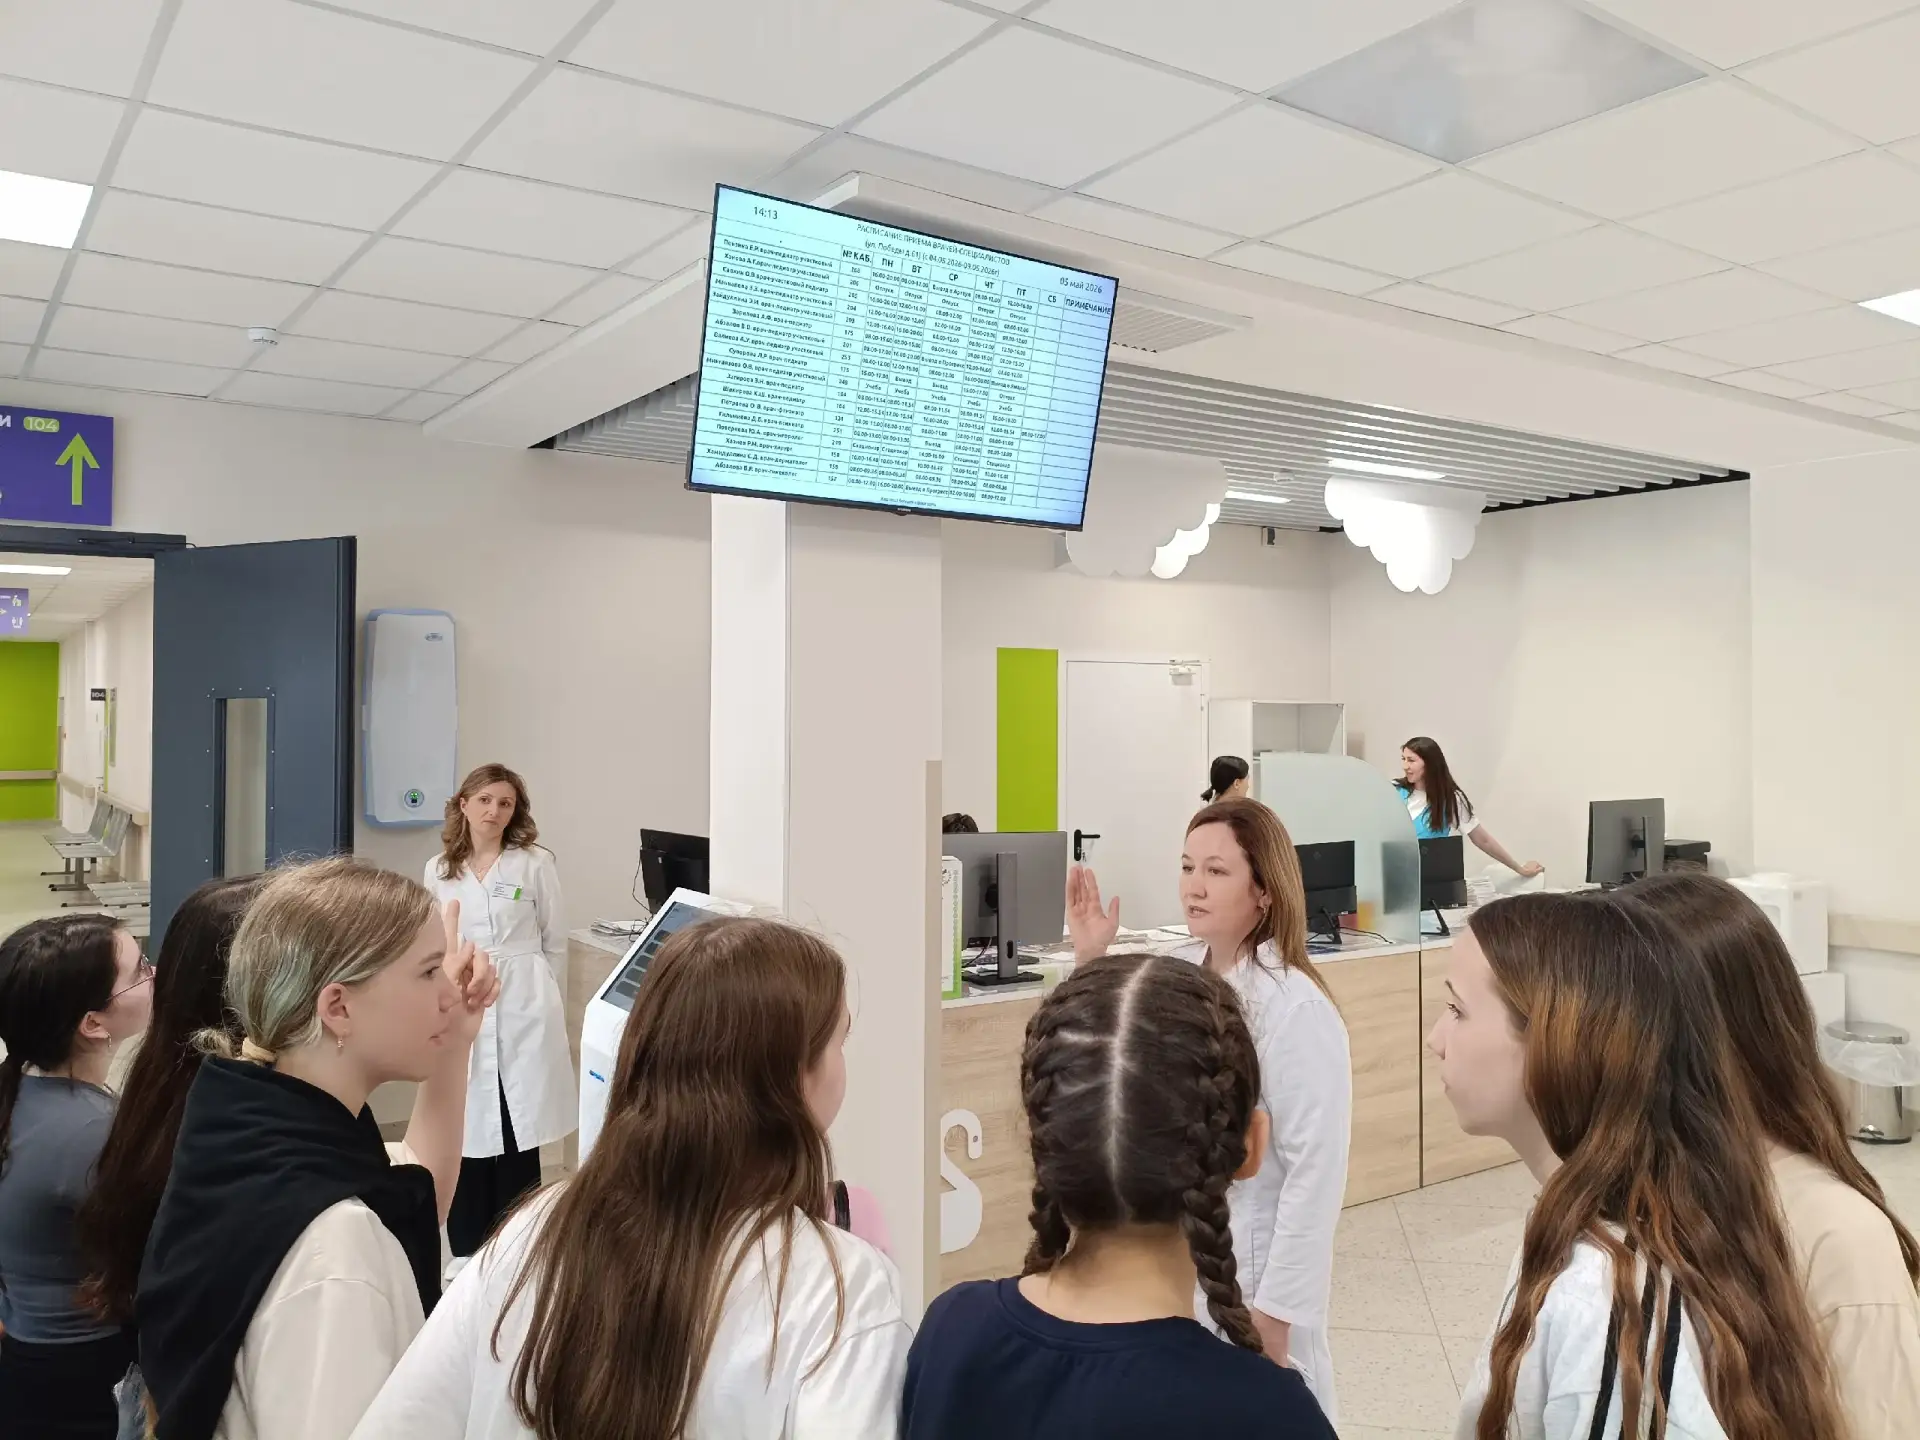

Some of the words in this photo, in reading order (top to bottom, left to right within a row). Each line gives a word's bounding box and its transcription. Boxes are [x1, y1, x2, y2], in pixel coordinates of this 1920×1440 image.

[753, 206, 778, 220] 14:13
[881, 257, 893, 267] ПН
[911, 264, 922, 273] ВТ
[948, 272, 958, 281] СР
[984, 280, 994, 289] ЧТ
[1015, 287, 1026, 297] ПТ
[1047, 294, 1057, 303] СБ
[1065, 298, 1111, 315] ПРИМЕЧАНИЕ
[1069, 279, 1084, 290] май
[1084, 282, 1103, 294] 2026
[28, 417, 58, 431] 104
